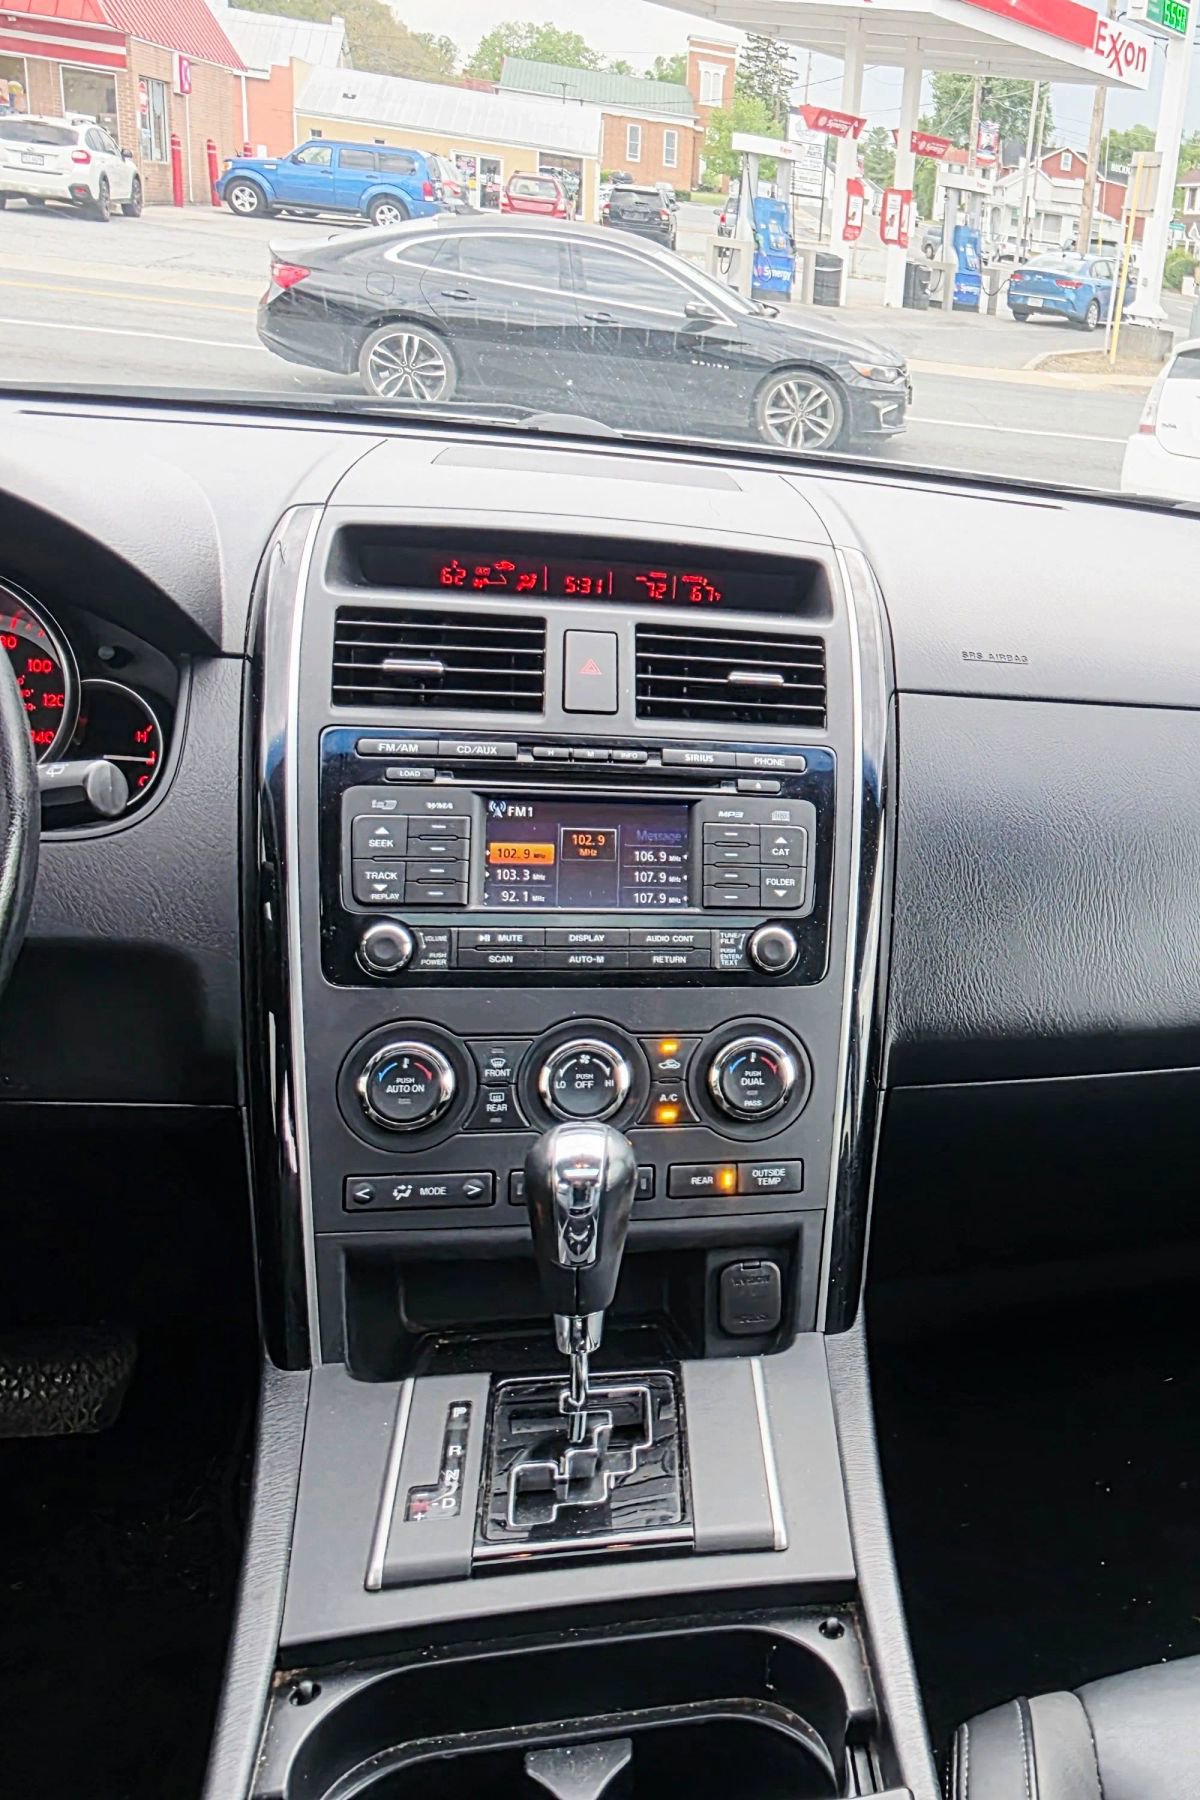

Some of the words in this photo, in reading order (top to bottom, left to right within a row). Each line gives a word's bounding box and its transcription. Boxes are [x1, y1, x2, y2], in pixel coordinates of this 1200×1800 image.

[1094, 20, 1147, 76] Exxon
[565, 576, 602, 594] 5:31
[962, 651, 983, 660] SRS
[988, 653, 1029, 663] AIRBAG
[27, 658, 52, 673] 100
[42, 692, 64, 707] 120
[378, 743, 419, 753] FM/AM
[456, 745, 498, 755] CD/AUX
[684, 753, 714, 763] SIRIUS
[753, 757, 785, 766] PHONE
[399, 770, 421, 778] LOAD
[507, 806, 533, 817] FM1
[718, 810, 744, 818] MP3
[572, 834, 606, 846] 102.9
[637, 830, 682, 842] Message
[368, 839, 394, 848] SEEK
[497, 849, 530, 859] 102.9
[634, 851, 667, 862] 106.9
[772, 848, 790, 856] CAT
[365, 872, 398, 880] TRACK
[496, 869, 530, 880] 103.3
[634, 873, 667, 883] 107.9
[766, 878, 796, 886] FOLDER
[501, 891, 529, 902] 92.1
[634, 893, 667, 904] 107.9
[498, 934, 523, 942] MUTE
[569, 934, 605, 943] DISPLAY
[646, 934, 670, 942] AUDIO
[672, 934, 694, 943] CONT
[489, 955, 513, 963] SCAN
[569, 955, 604, 963] AUTO-M
[653, 955, 687, 964] RETURN
[484, 1069, 511, 1077] FRONT
[556, 1081, 566, 1089] LO
[575, 1080, 594, 1089] OFF
[604, 1079, 614, 1087] HI
[740, 1077, 765, 1086] DUAL
[386, 1084, 410, 1093] AUTO
[411, 1084, 425, 1093] ON
[659, 1093, 678, 1102] A/C
[486, 1104, 508, 1112] REAR
[752, 1169, 786, 1177] OUTSIDE
[691, 1176, 713, 1185] REAR
[757, 1177, 782, 1185] TEMP
[420, 1187, 447, 1195] MODE
[452, 1407, 467, 1418] P
[448, 1445, 462, 1455] R
[445, 1469, 459, 1481] N
[442, 1497, 456, 1509] D
